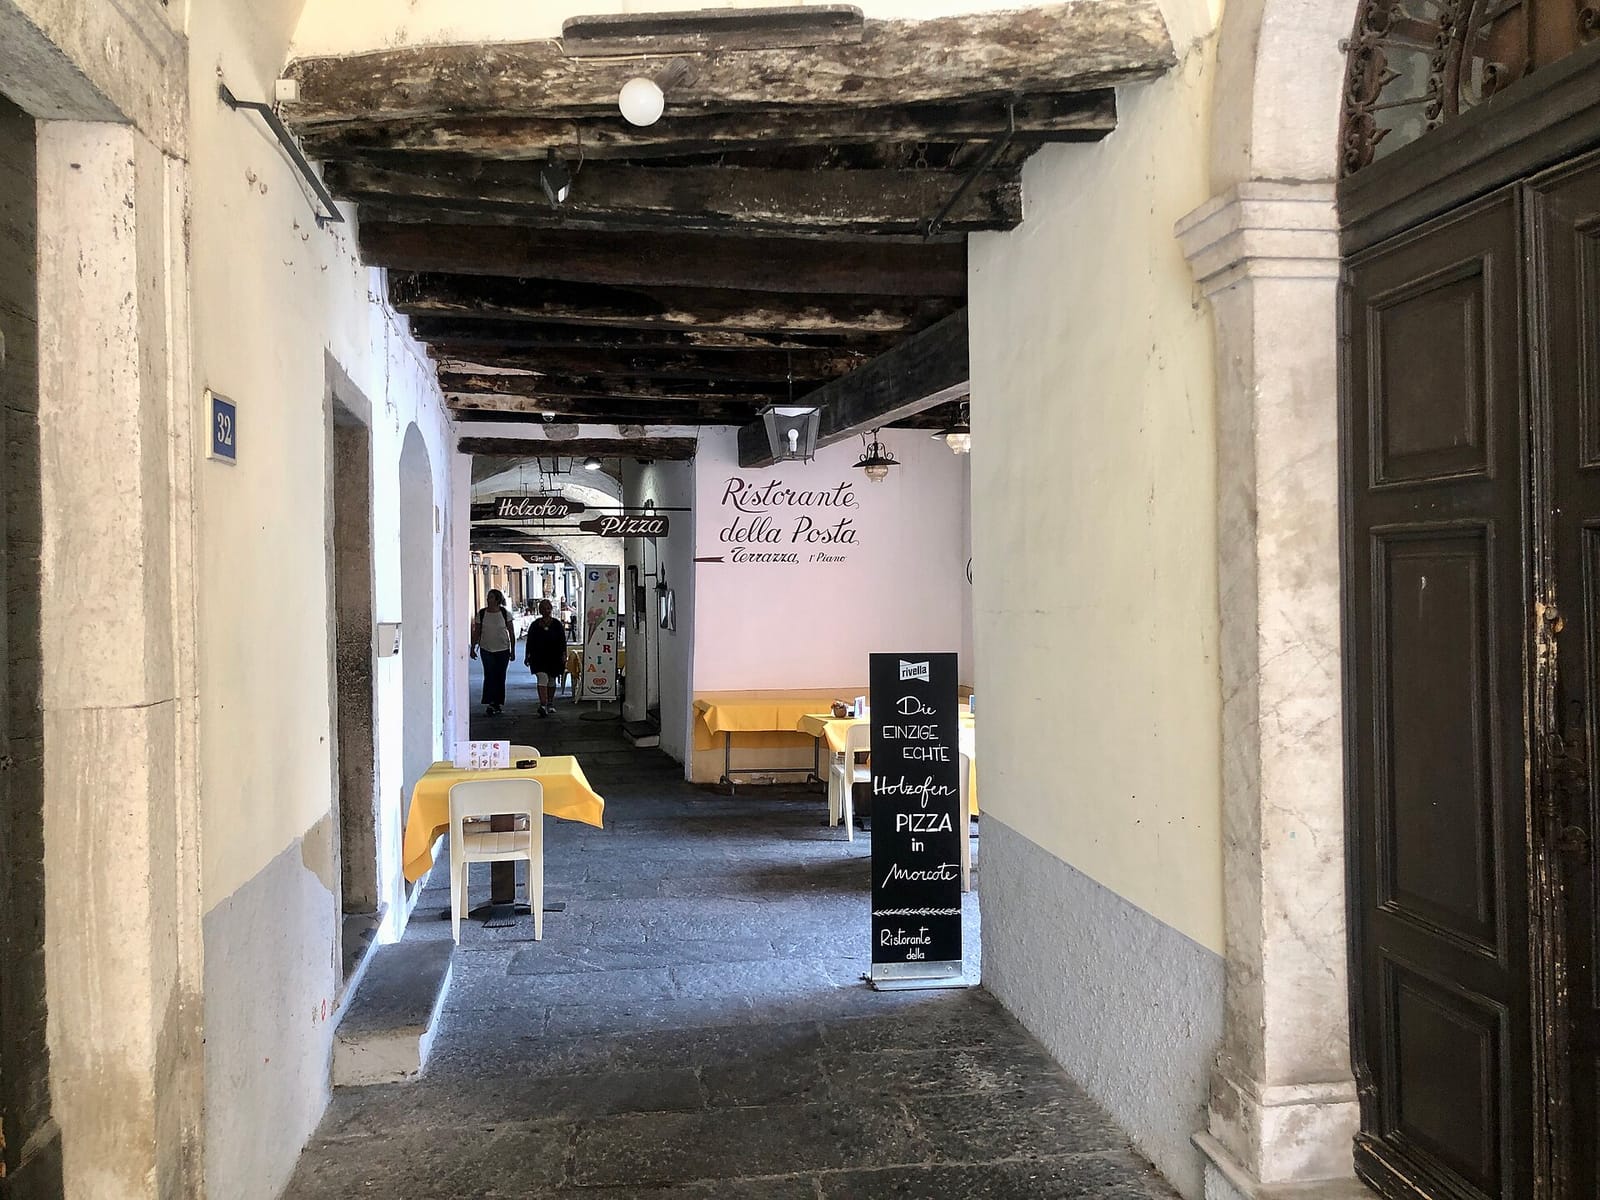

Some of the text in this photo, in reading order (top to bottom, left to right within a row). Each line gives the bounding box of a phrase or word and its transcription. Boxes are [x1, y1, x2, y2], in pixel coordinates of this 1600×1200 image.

[217, 412, 231, 446] 32
[721, 477, 860, 514] Ristorante
[499, 498, 568, 516] Holzofen
[600, 516, 664, 536] Pizza
[719, 515, 860, 545] della Posta
[816, 552, 846, 562] Piano
[902, 665, 927, 677] rivella
[896, 695, 936, 715] Die
[882, 725, 939, 740] EINZIGE
[903, 745, 950, 762] ECHTE
[873, 775, 956, 808] Holzofen
[896, 812, 952, 832] PIZZA
[911, 838, 924, 852] in
[881, 862, 959, 889] Morcote
[880, 926, 932, 947] Ristorante
[906, 947, 925, 960] della
